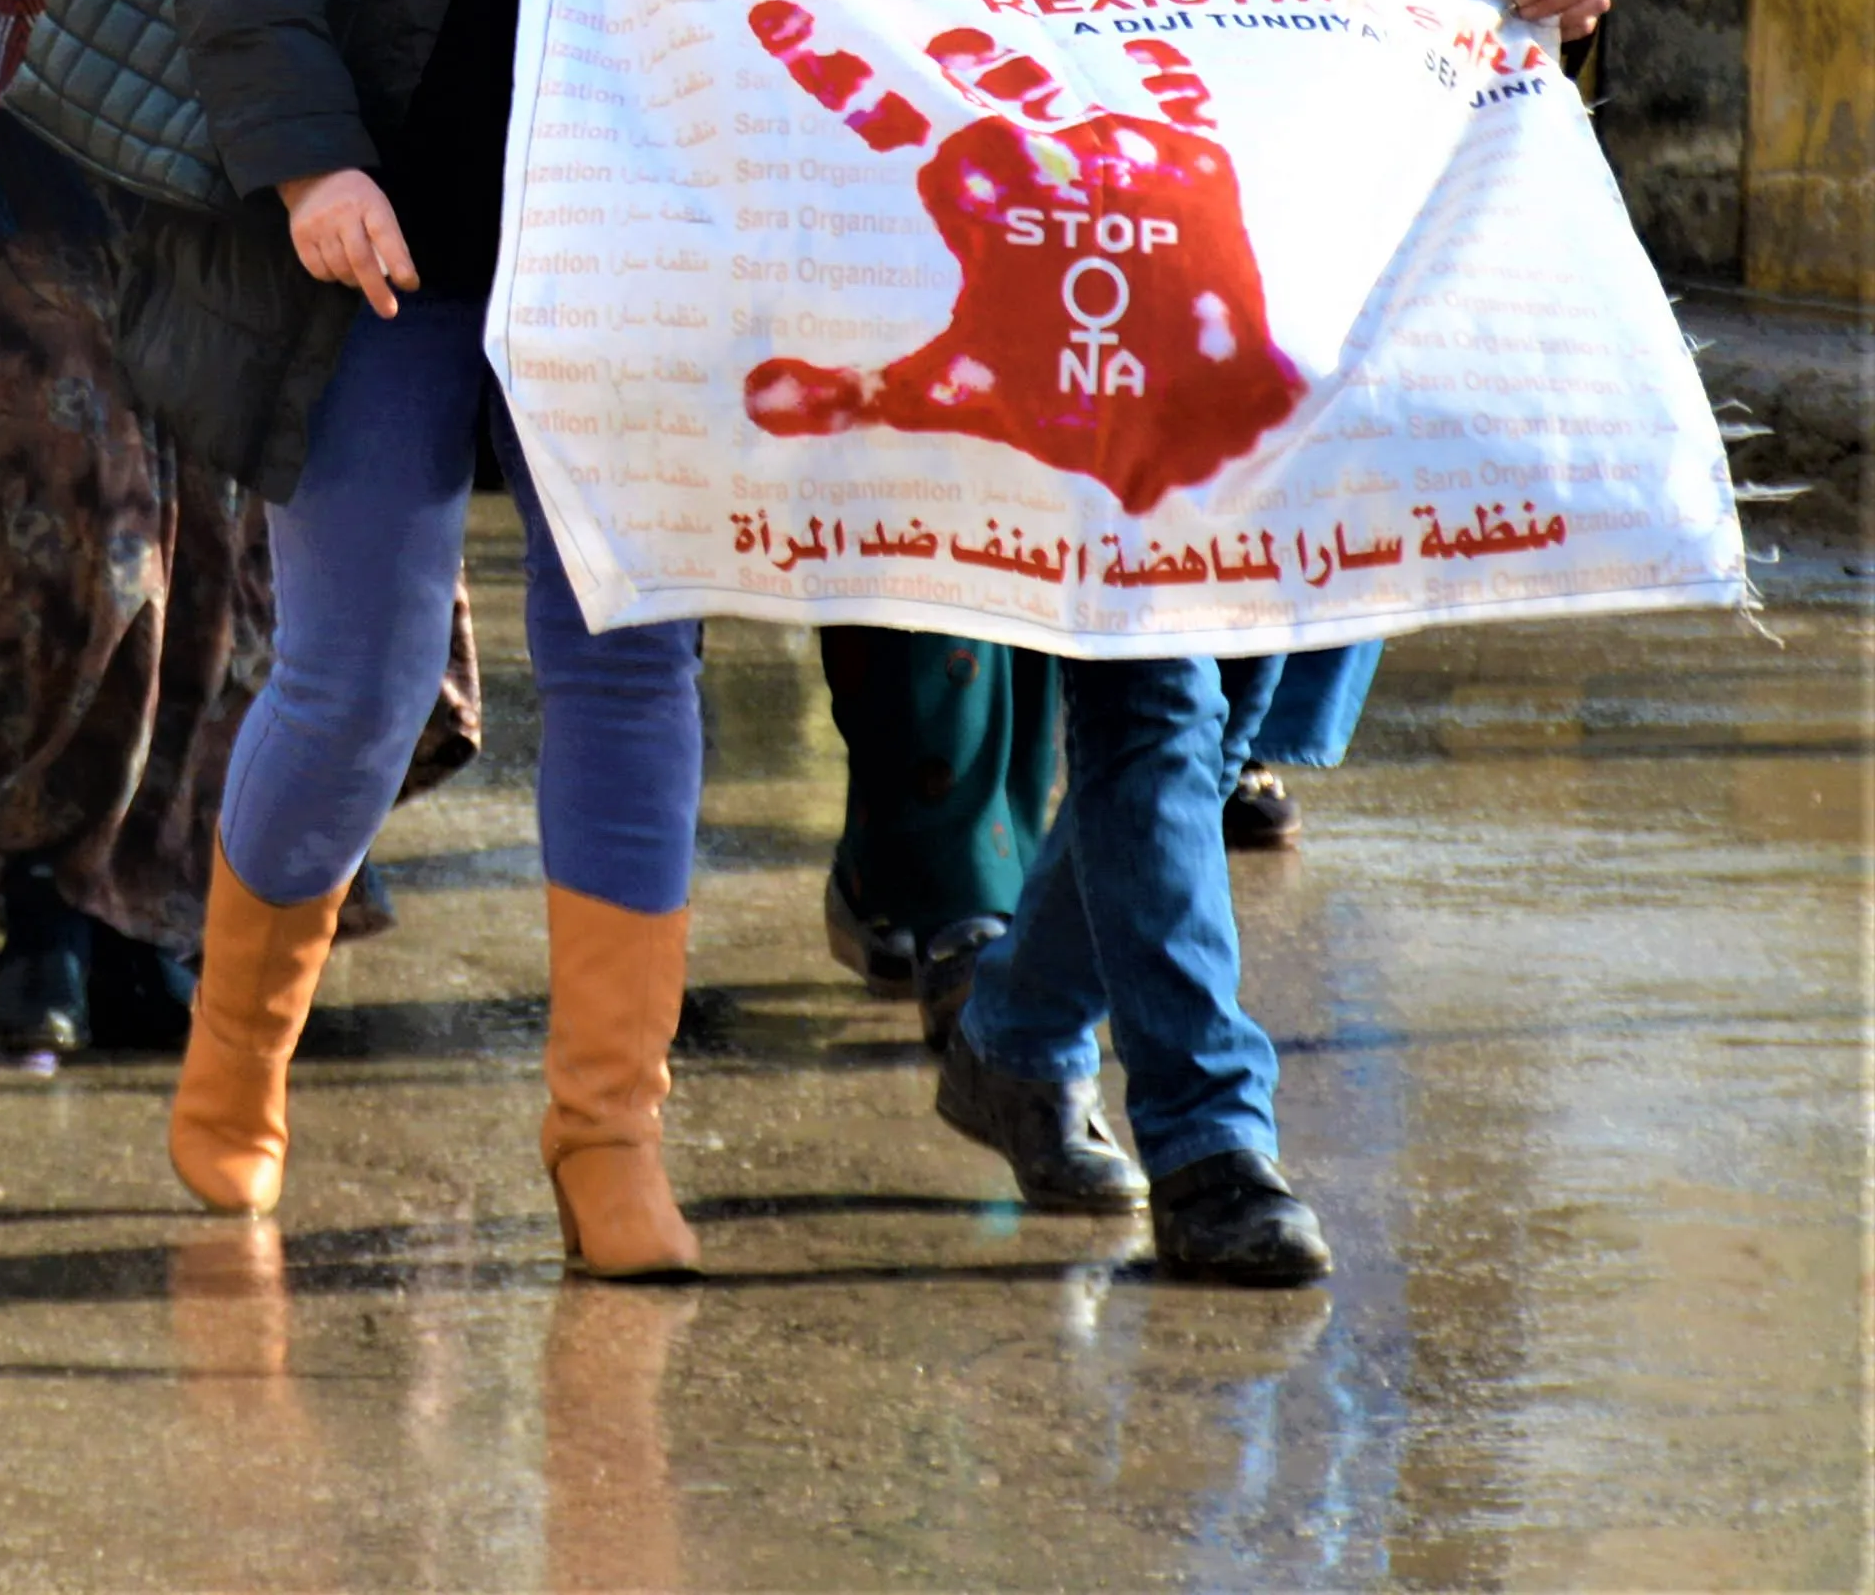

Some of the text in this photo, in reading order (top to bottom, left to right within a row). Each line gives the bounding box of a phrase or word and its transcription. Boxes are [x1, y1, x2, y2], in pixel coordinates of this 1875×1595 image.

[1074, 21, 1100, 35] A
[1113, 11, 1194, 33] DIJÎ
[1005, 207, 1178, 254] STOP
[797, 256, 949, 291] Organizatio
[1058, 346, 1146, 398] NA
[729, 500, 1566, 589] منظمة سارا لمناهضة العنف ضد المرأة
